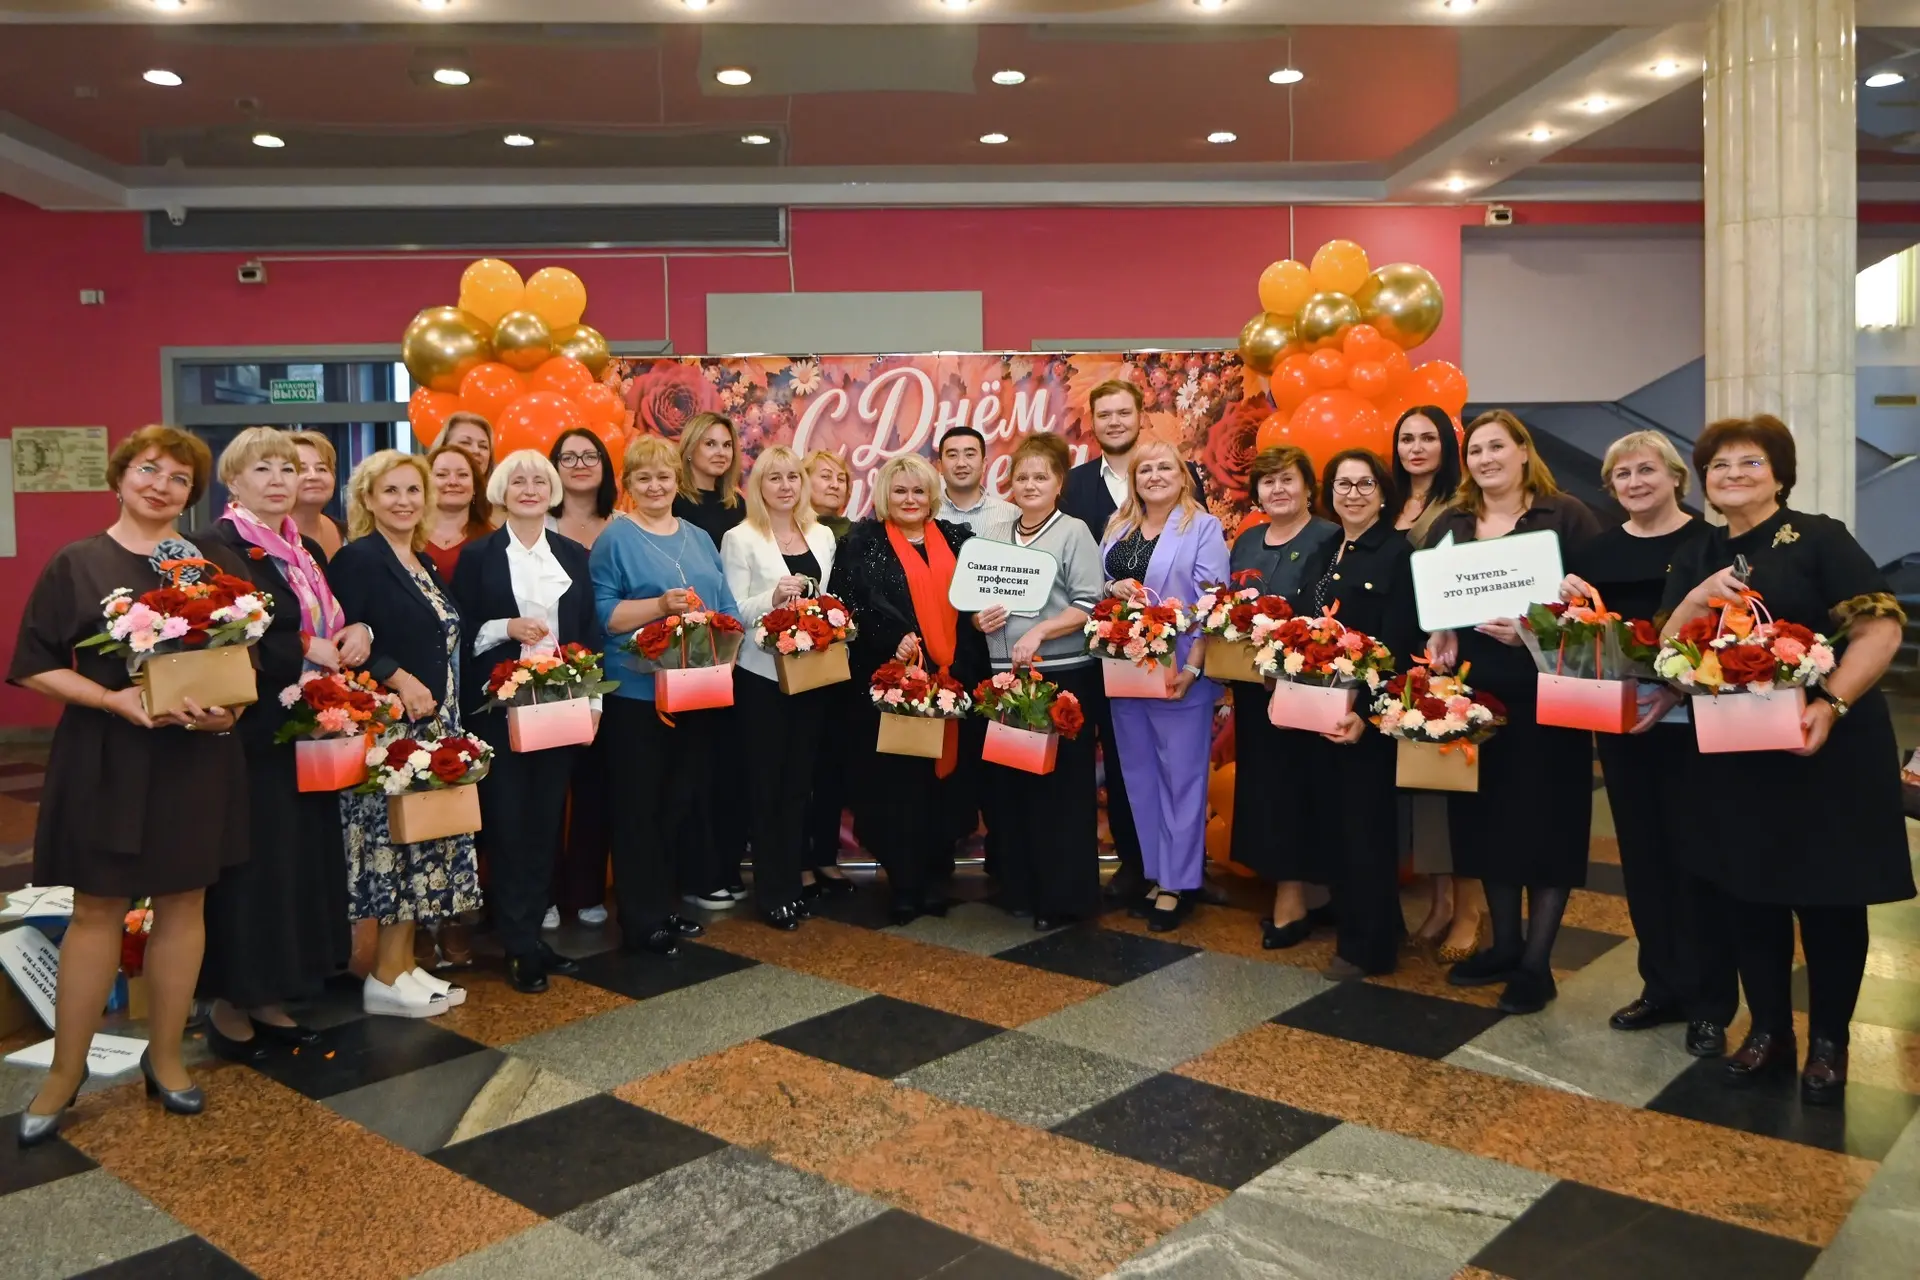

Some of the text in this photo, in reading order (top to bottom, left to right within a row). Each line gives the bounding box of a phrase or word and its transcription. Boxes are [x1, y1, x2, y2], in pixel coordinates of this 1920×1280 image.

[273, 389, 316, 400] ВЫХОД
[967, 561, 1040, 575] Самая главная
[977, 574, 1029, 585] профессия
[1455, 569, 1508, 583] Учитель
[979, 586, 1026, 597] на Земле!
[1443, 576, 1535, 599] это призвание!
